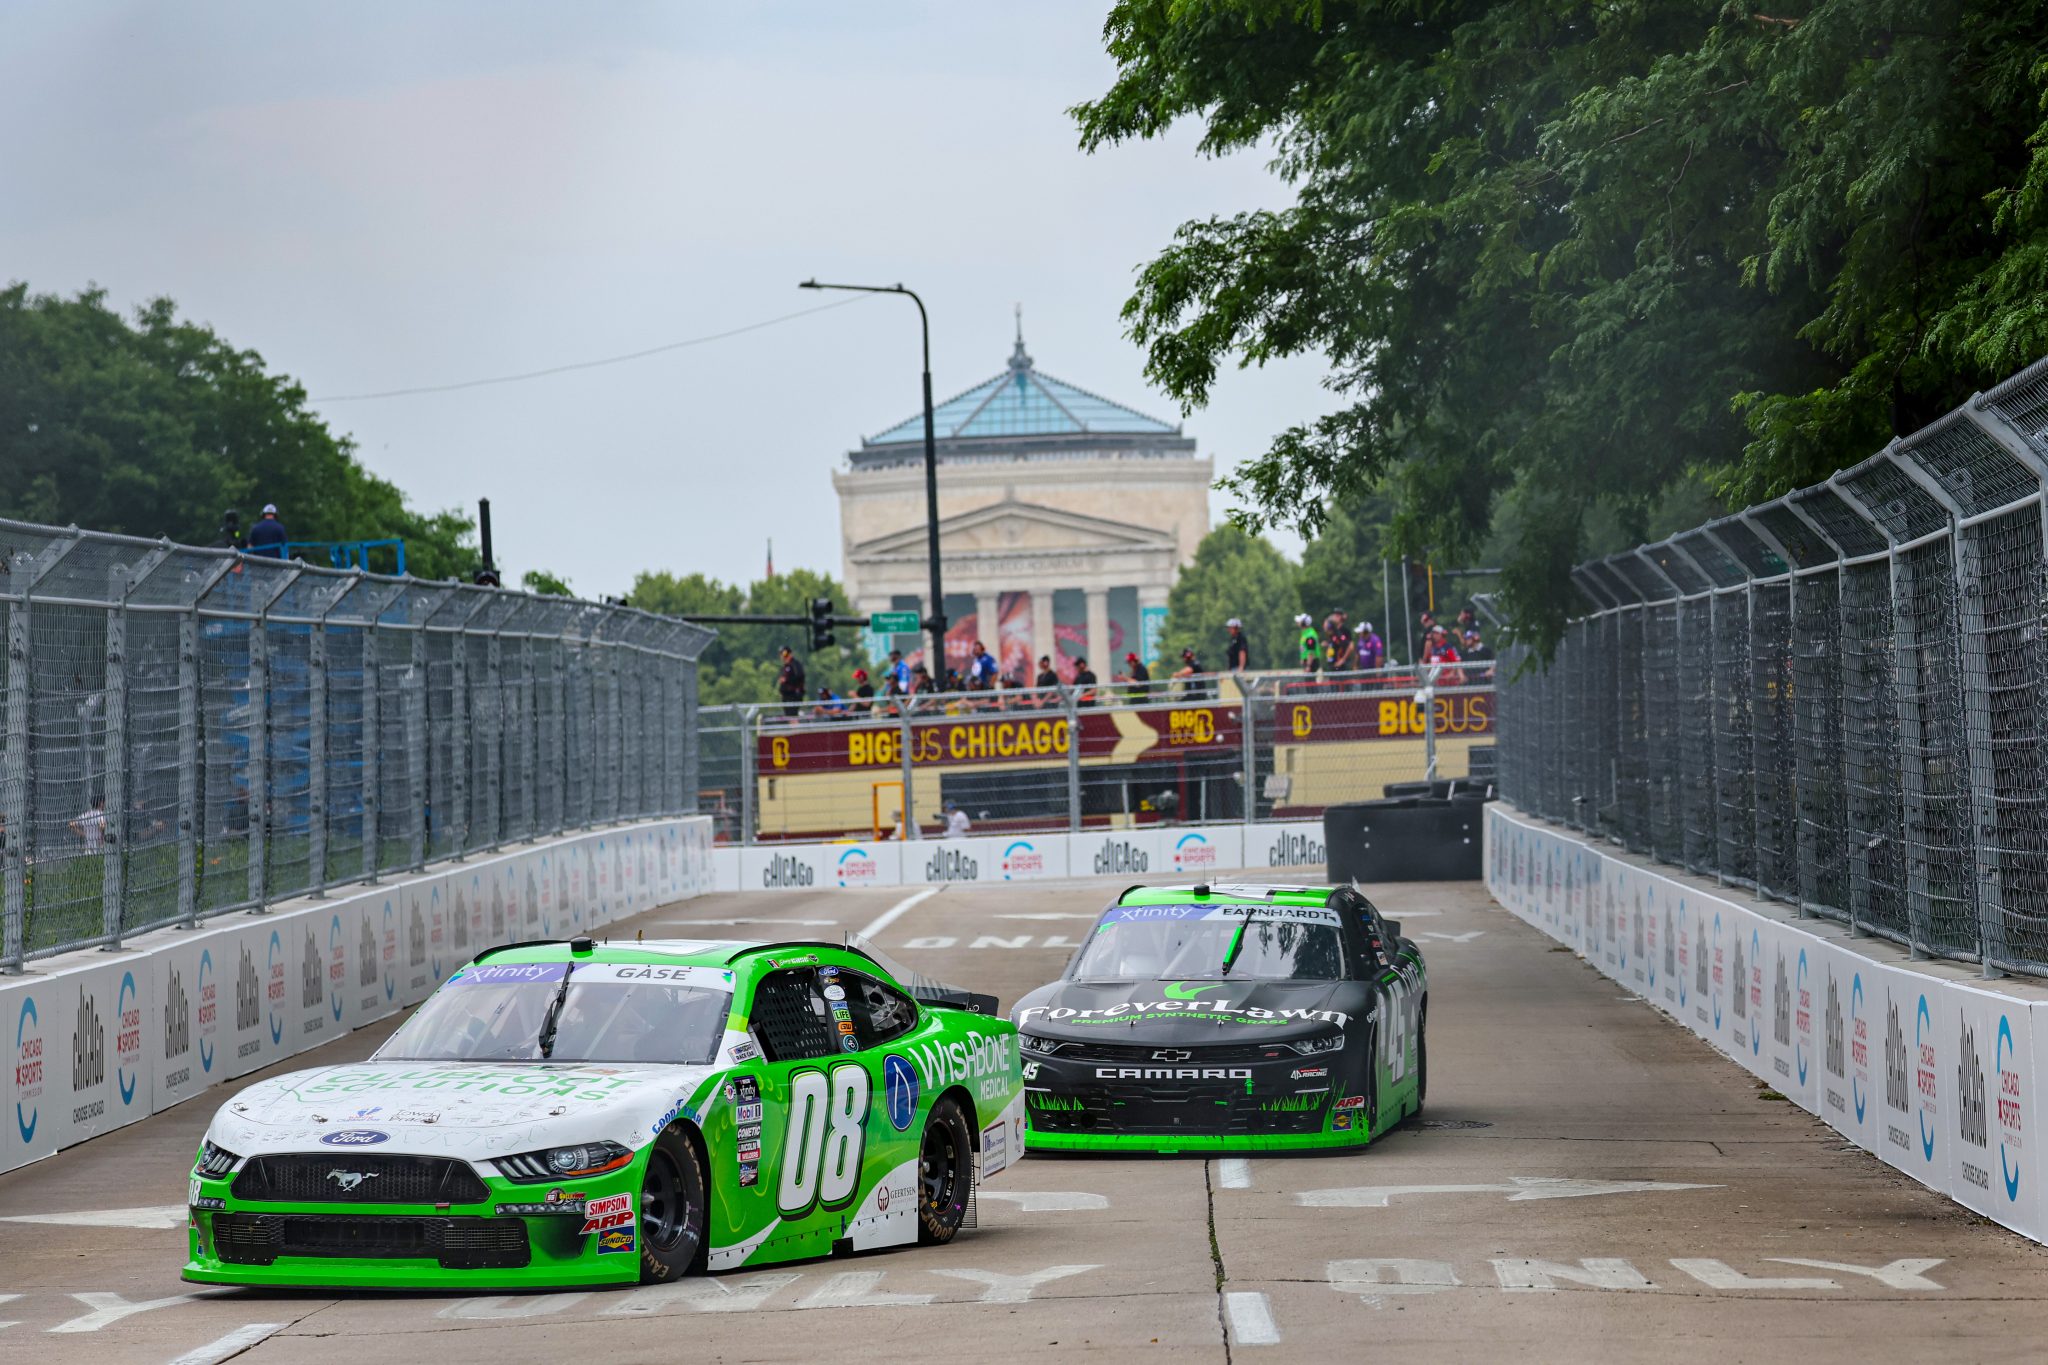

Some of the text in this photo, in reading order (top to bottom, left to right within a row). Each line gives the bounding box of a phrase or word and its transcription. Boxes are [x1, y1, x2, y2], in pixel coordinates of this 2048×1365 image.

[950, 719, 1070, 759] CHICAGO
[926, 847, 978, 881] CHICAGO
[1094, 838, 1148, 874] CHICAGO
[763, 853, 814, 888] CHICAGO
[1120, 907, 1330, 921] xfinity EARNHARDT
[466, 966, 691, 983] xfinity GASE
[122, 1008, 139, 1029] CHICAGO
[835, 1010, 850, 1019] LIFE
[1018, 999, 1349, 1031] ForeverLawn
[1071, 1012, 1288, 1025] PREMIUM SYNTHETIC GRASS
[22, 1037, 42, 1060] CHICAGO
[73, 982, 104, 1092] CHICAGO
[122, 1030, 139, 1053] SPORTS
[21, 1060, 42, 1087] SPORTS
[326, 1071, 642, 1090] CLUBFOOT
[1022, 1062, 1040, 1080] 45
[1096, 1068, 1252, 1079] CAMARO
[305, 1080, 611, 1101] SOLUTIONS
[981, 1077, 1010, 1101] MEDICAL
[1921, 1069, 1936, 1099] SPORTS
[2001, 1069, 2019, 1097] CHICAGO
[73, 1100, 104, 1124] CHOOSE CHICAGO
[737, 1106, 753, 1119] Mobil
[1335, 1096, 1363, 1108] ARP
[2002, 1098, 2021, 1131] SPORTS
[332, 1130, 377, 1143] Ford
[776, 1062, 870, 1212] 08
[1975, 1166, 1989, 1190] CHICAGO
[890, 1186, 916, 1199] GEERTSEN
[589, 1196, 628, 1216] SIMPSON
[581, 1211, 634, 1232] ARP
[600, 1235, 633, 1246] SUNOCO
[1326, 1258, 1947, 1296] ONLY
